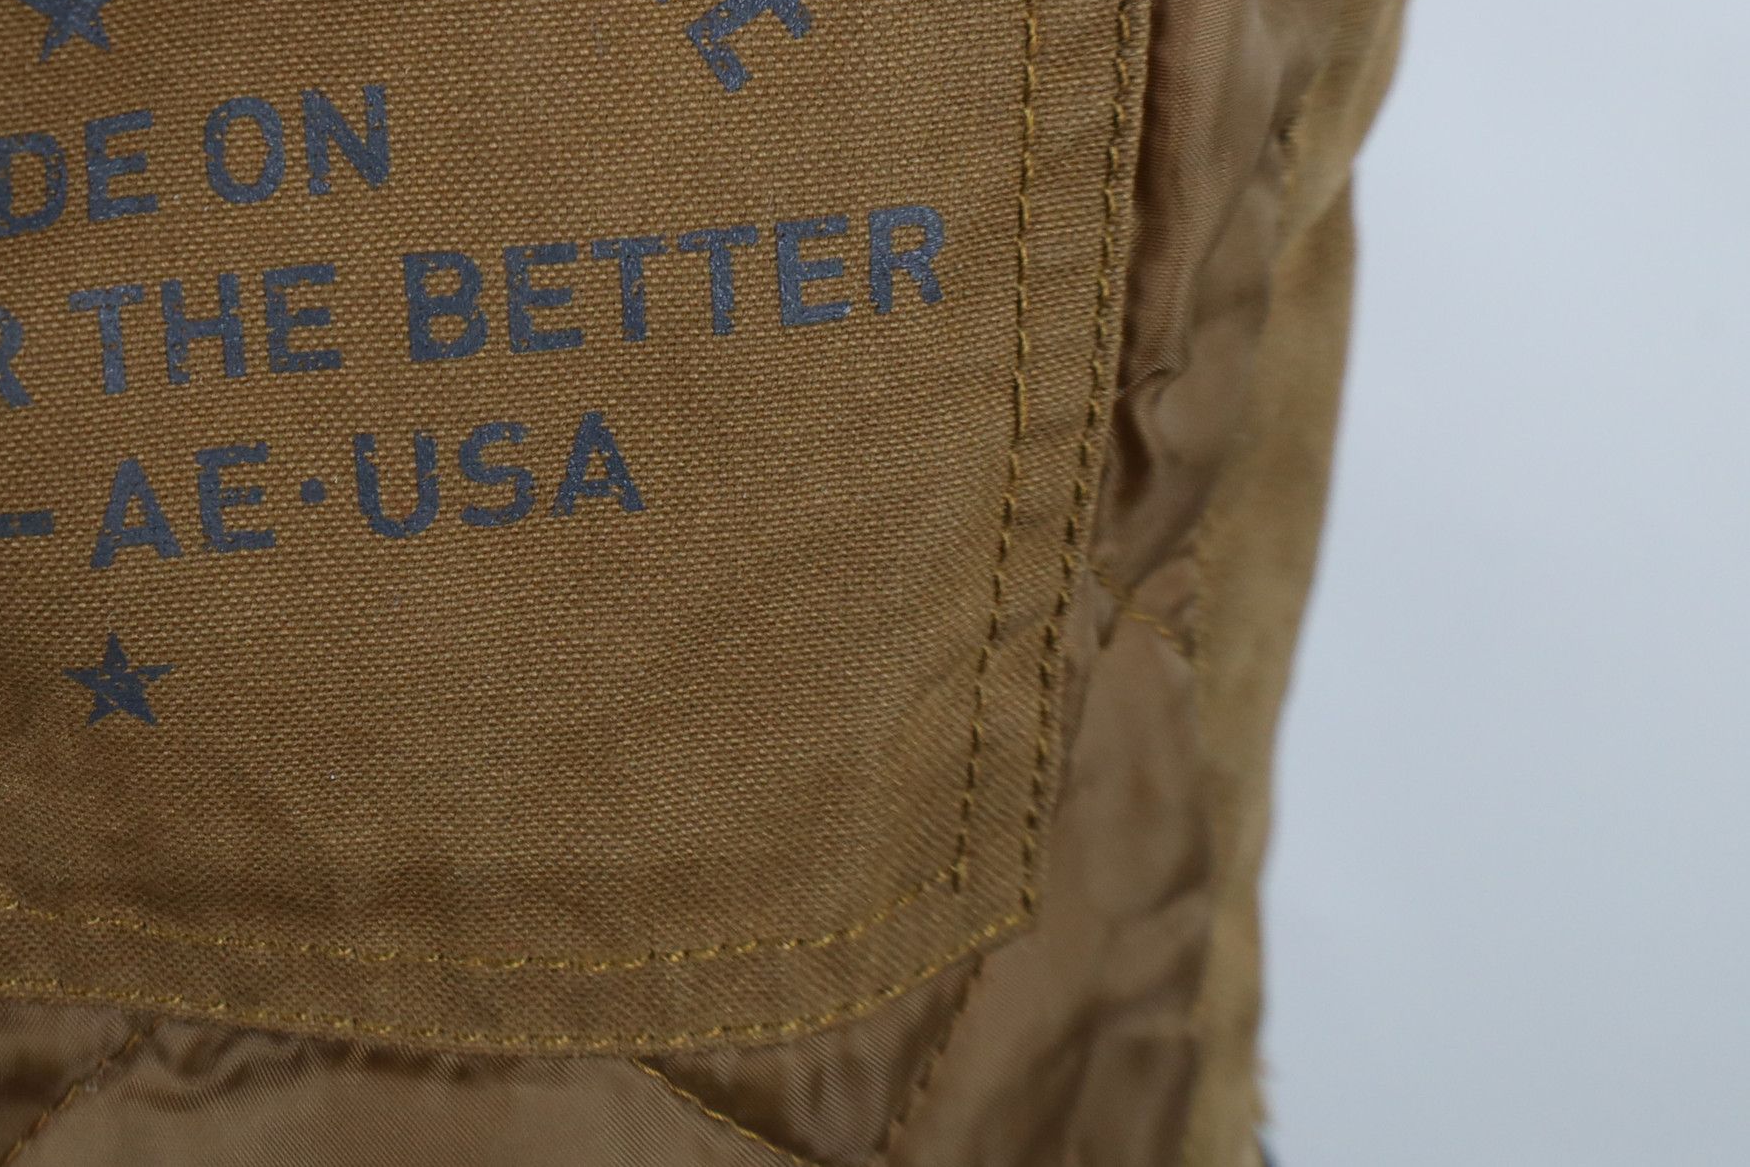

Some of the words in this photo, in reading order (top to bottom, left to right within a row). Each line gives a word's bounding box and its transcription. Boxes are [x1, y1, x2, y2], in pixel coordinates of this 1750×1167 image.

[202, 83, 391, 204] ON
[67, 262, 343, 396] THE
[401, 204, 946, 363] BETTER
